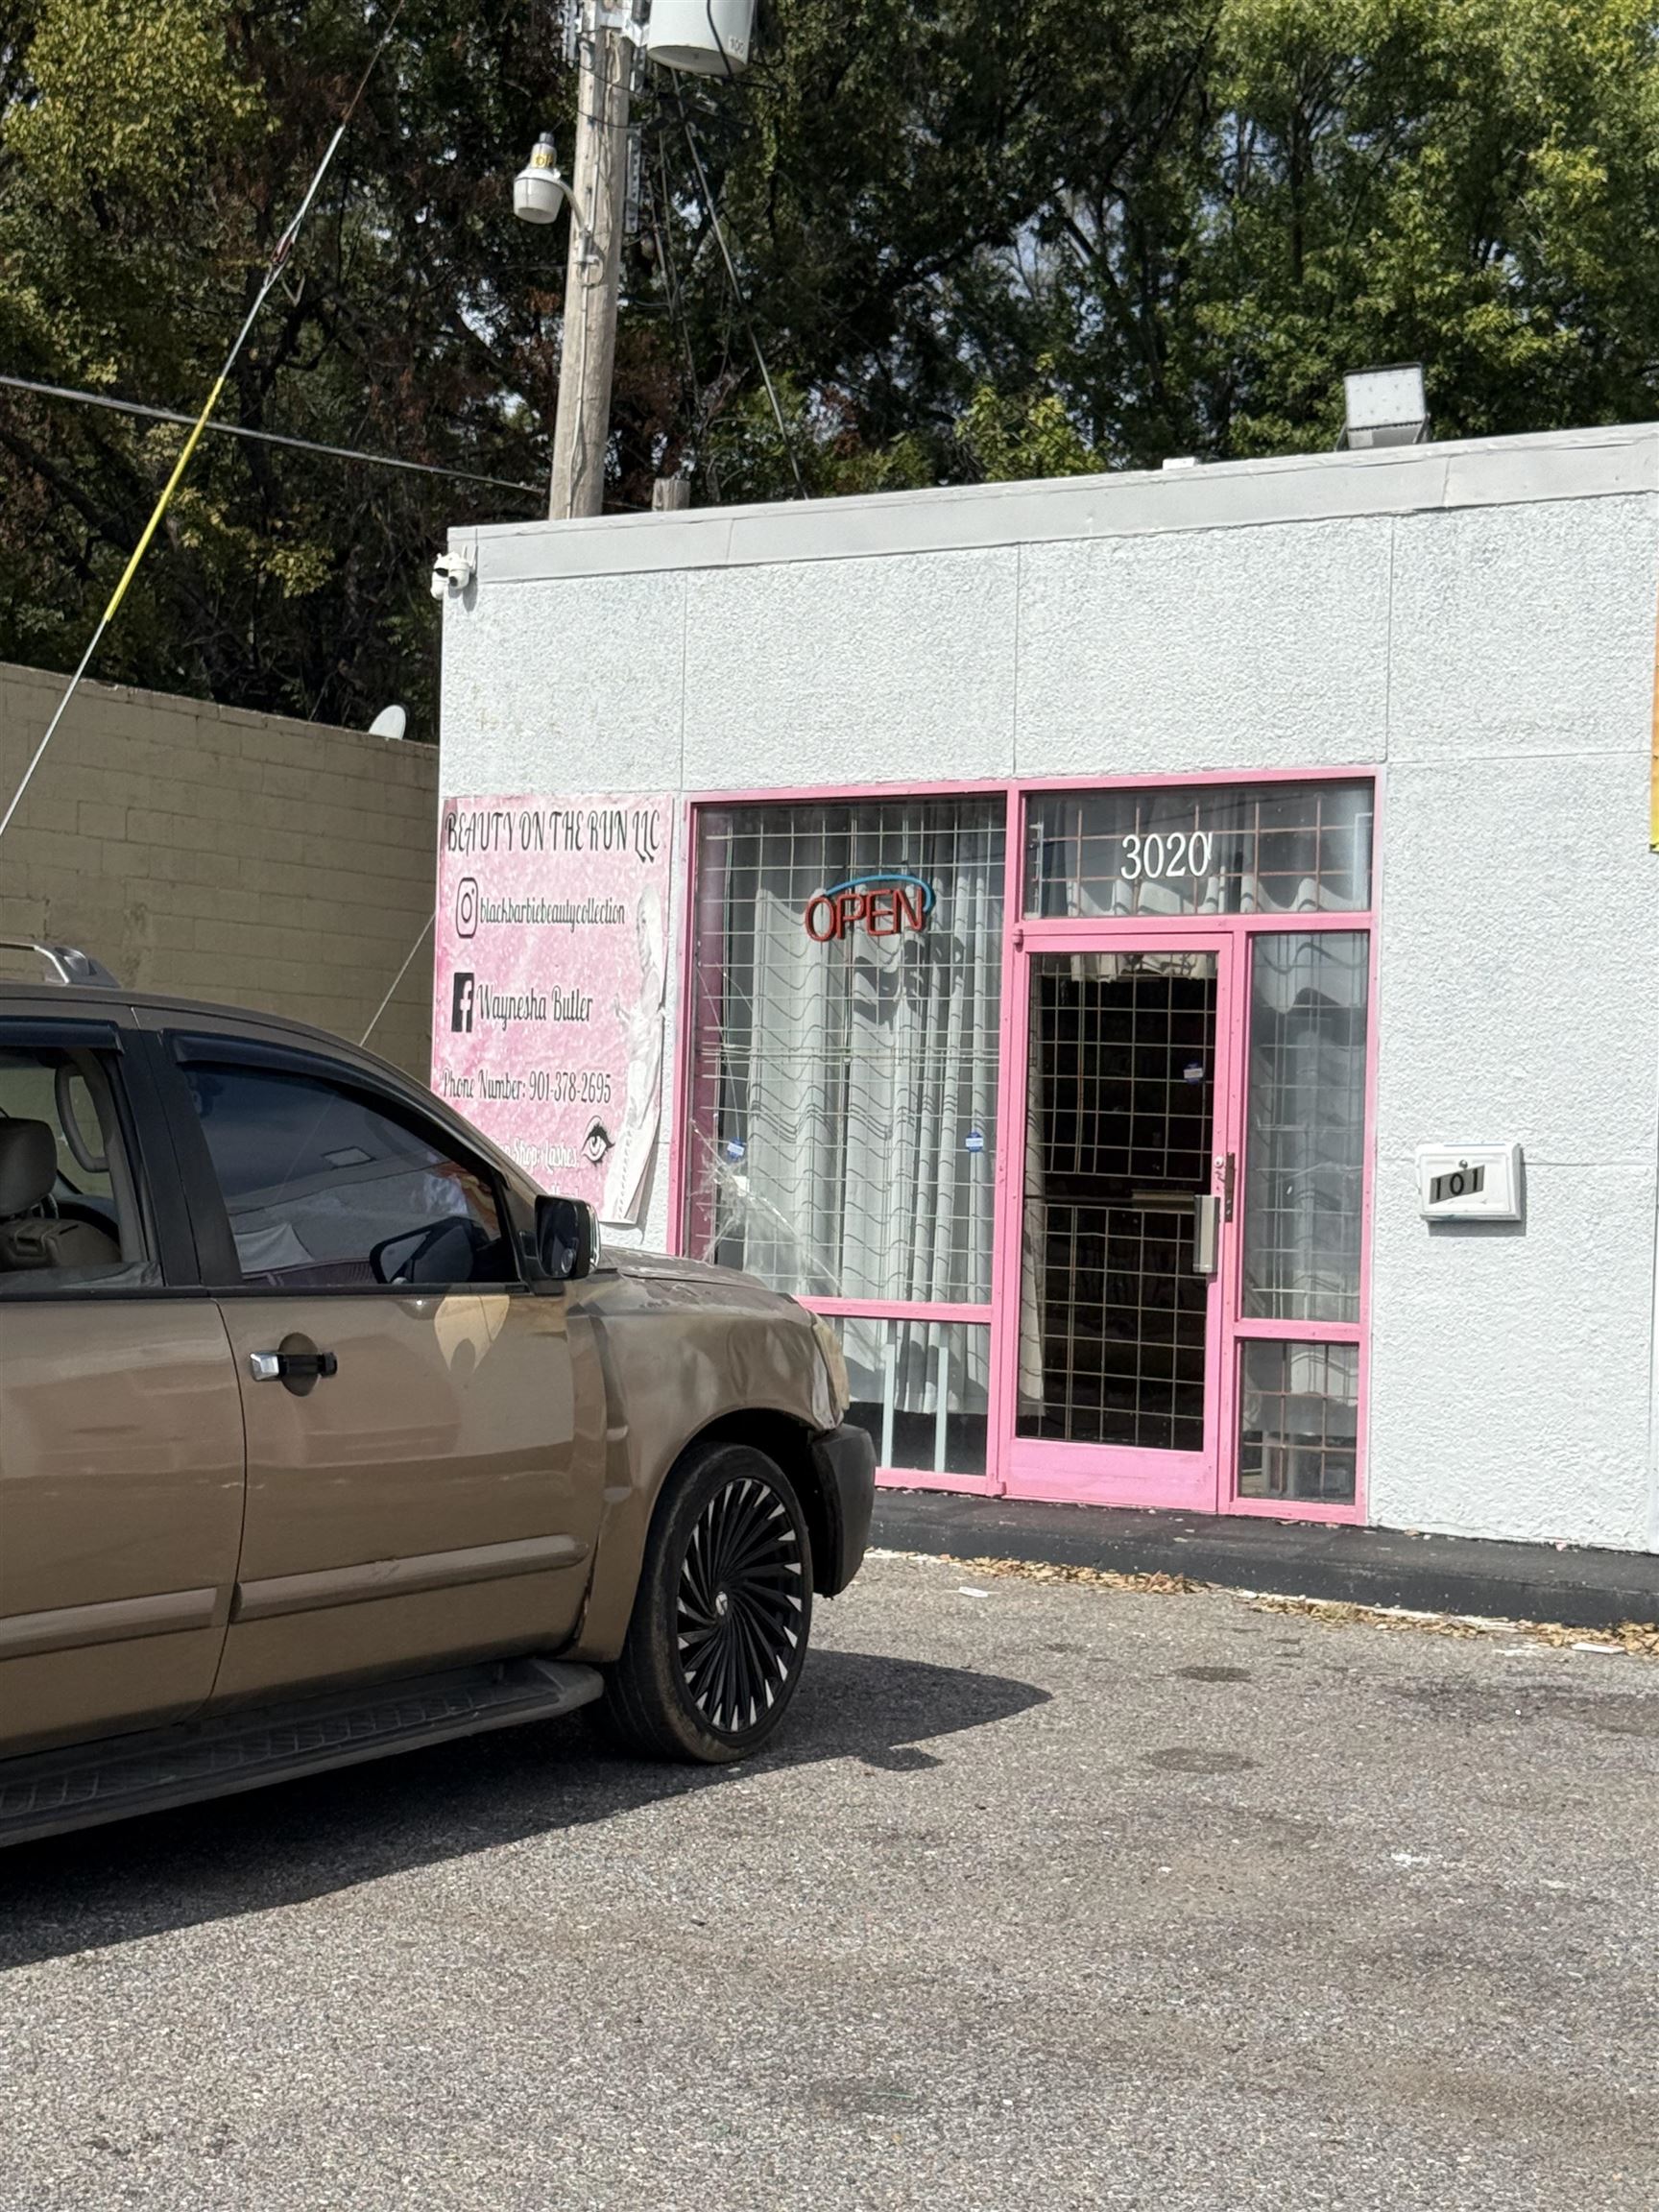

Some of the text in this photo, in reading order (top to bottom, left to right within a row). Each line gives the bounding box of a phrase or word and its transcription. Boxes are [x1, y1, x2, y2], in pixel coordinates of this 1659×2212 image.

[445, 809, 660, 863] BEAUTY ON THE RUN LLC
[1120, 831, 1214, 879] 3020
[479, 897, 626, 933] blackbarbiebeautycollection
[805, 886, 923, 942] OPEN
[477, 984, 593, 1032] Waynesha Butler
[443, 1068, 612, 1103] Phone Number: 901-378-2695
[1436, 1167, 1479, 1200] 101
